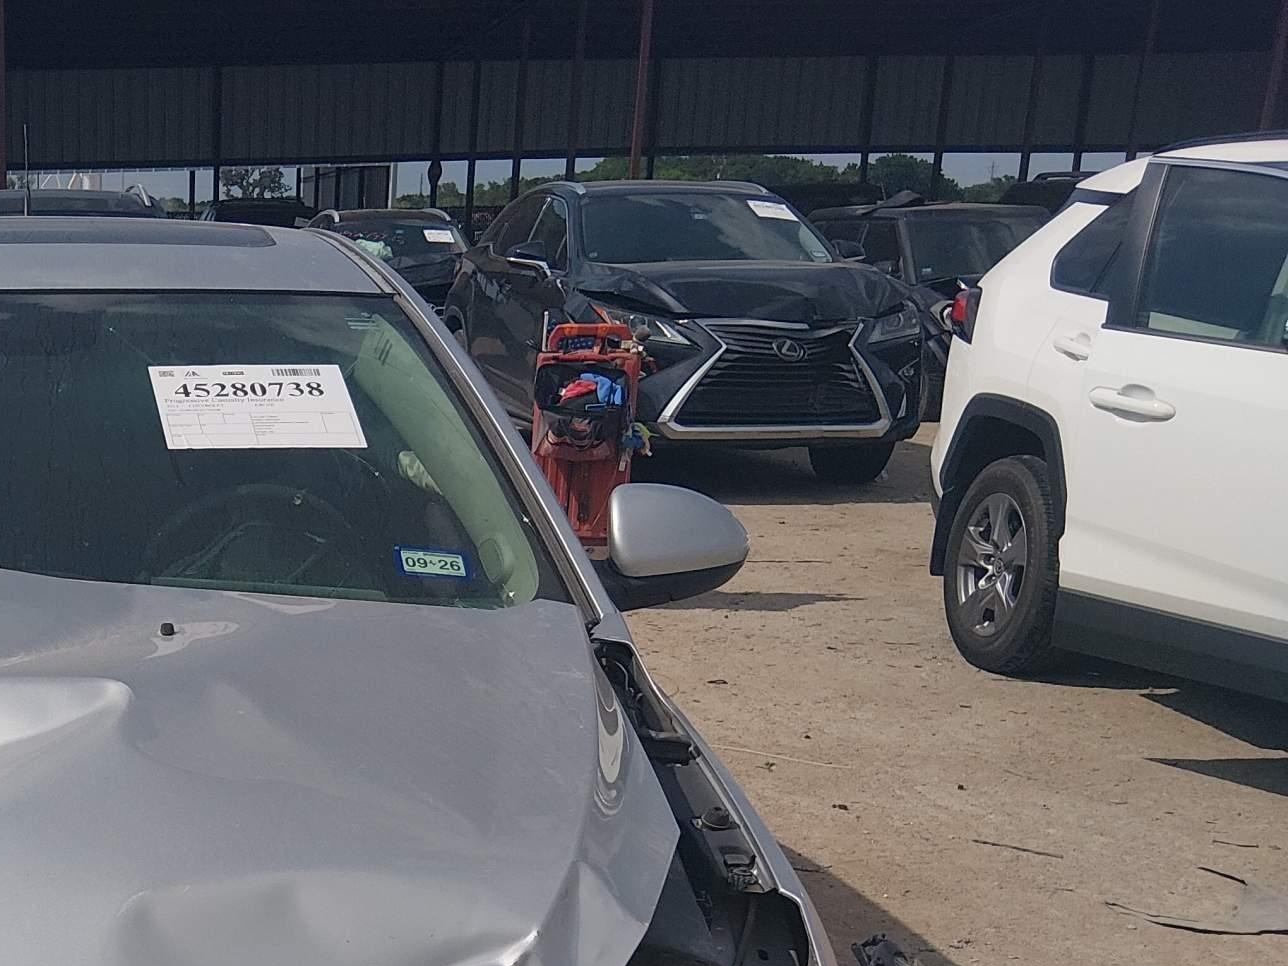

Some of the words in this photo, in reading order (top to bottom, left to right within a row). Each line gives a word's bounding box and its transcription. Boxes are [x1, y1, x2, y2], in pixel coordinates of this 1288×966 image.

[174, 381, 325, 398] 45280738
[405, 556, 428, 569] 09
[438, 559, 461, 571] 26
